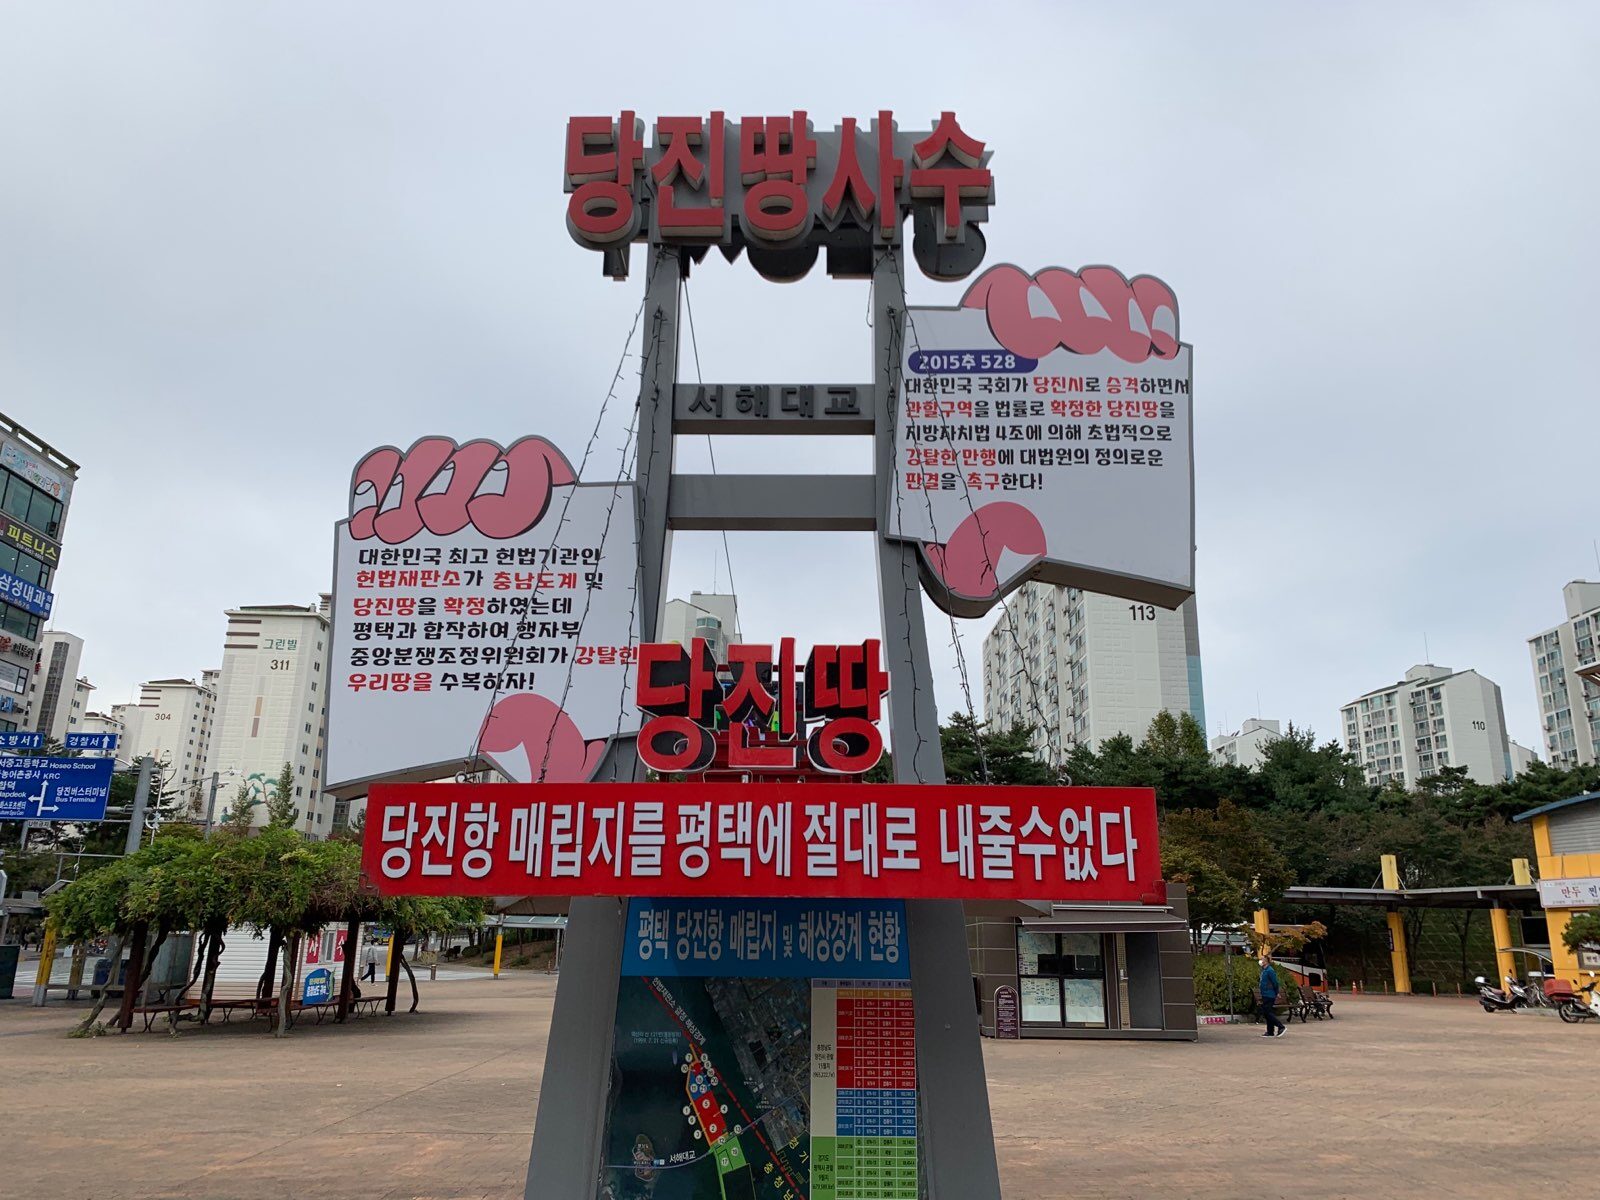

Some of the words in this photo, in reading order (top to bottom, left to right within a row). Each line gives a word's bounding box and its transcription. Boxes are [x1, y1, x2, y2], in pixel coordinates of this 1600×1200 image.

[565, 110, 993, 242] 당진땅사수
[919, 354, 973, 370] 2015추
[981, 355, 1016, 370] 528
[905, 377, 972, 394] 대한민국
[978, 377, 1028, 393] 국회가
[1033, 376, 1101, 393] 당진시로
[1106, 377, 1190, 395] 승격하면서
[688, 385, 860, 418] 서해대교
[905, 400, 989, 419] 관할구역을
[995, 400, 1046, 418] 법률로
[1050, 400, 1102, 418] 확정한
[1107, 401, 1175, 419] 당진땅을
[905, 424, 990, 442] 지방자치법
[996, 424, 1042, 441] 4조에
[1048, 424, 1081, 441] 의해
[1088, 425, 1172, 442] 초법적으로
[905, 448, 956, 466] 강탈한
[962, 448, 1014, 466] 만행에
[1020, 449, 1089, 466] 대법원의
[1095, 449, 1163, 466] 정의로운
[905, 472, 956, 490] 판결을
[967, 472, 1043, 490] 촉구한다!
[7, 524, 57, 561] 피트니스
[358, 547, 442, 566] 대한민국
[448, 548, 488, 565] 최고
[495, 548, 600, 566] 헌법기관인
[356, 569, 484, 589] 헌법재판소가
[493, 571, 577, 590] 충남도계
[584, 572, 603, 590] 및
[0, 574, 46, 608] 삼성내과
[353, 597, 437, 616] 당진땅을
[443, 597, 572, 616] 확정하였는데
[1129, 605, 1156, 621] 113
[352, 621, 417, 641] 평택과
[423, 621, 509, 640] 합작하여
[516, 621, 580, 639] 행자부
[263, 638, 298, 650] 그린빌
[270, 659, 290, 670] 311
[350, 647, 568, 666] 중앙분쟁조정위원회가
[576, 646, 638, 665] 강탈한
[347, 672, 433, 692] 우리땅을
[439, 672, 535, 691] 수복하자!
[636, 637, 891, 774] 당진땅
[154, 713, 171, 721] 304
[1472, 720, 1486, 731] 110
[69, 736, 99, 747] 경찰서
[72, 762, 96, 770] School
[56, 786, 107, 797] 당진버스터미널
[381, 802, 499, 878] 당진항
[508, 801, 666, 878] 매립지를
[676, 801, 792, 878] 평택에
[803, 802, 920, 878] 절대로
[939, 804, 1138, 881] 내줄수없다
[638, 908, 671, 960] 평택
[675, 908, 724, 960] 당진항
[730, 909, 777, 960] 매립지
[782, 925, 793, 958] 및
[798, 909, 863, 962] 해상경계
[868, 910, 901, 963] 현황
